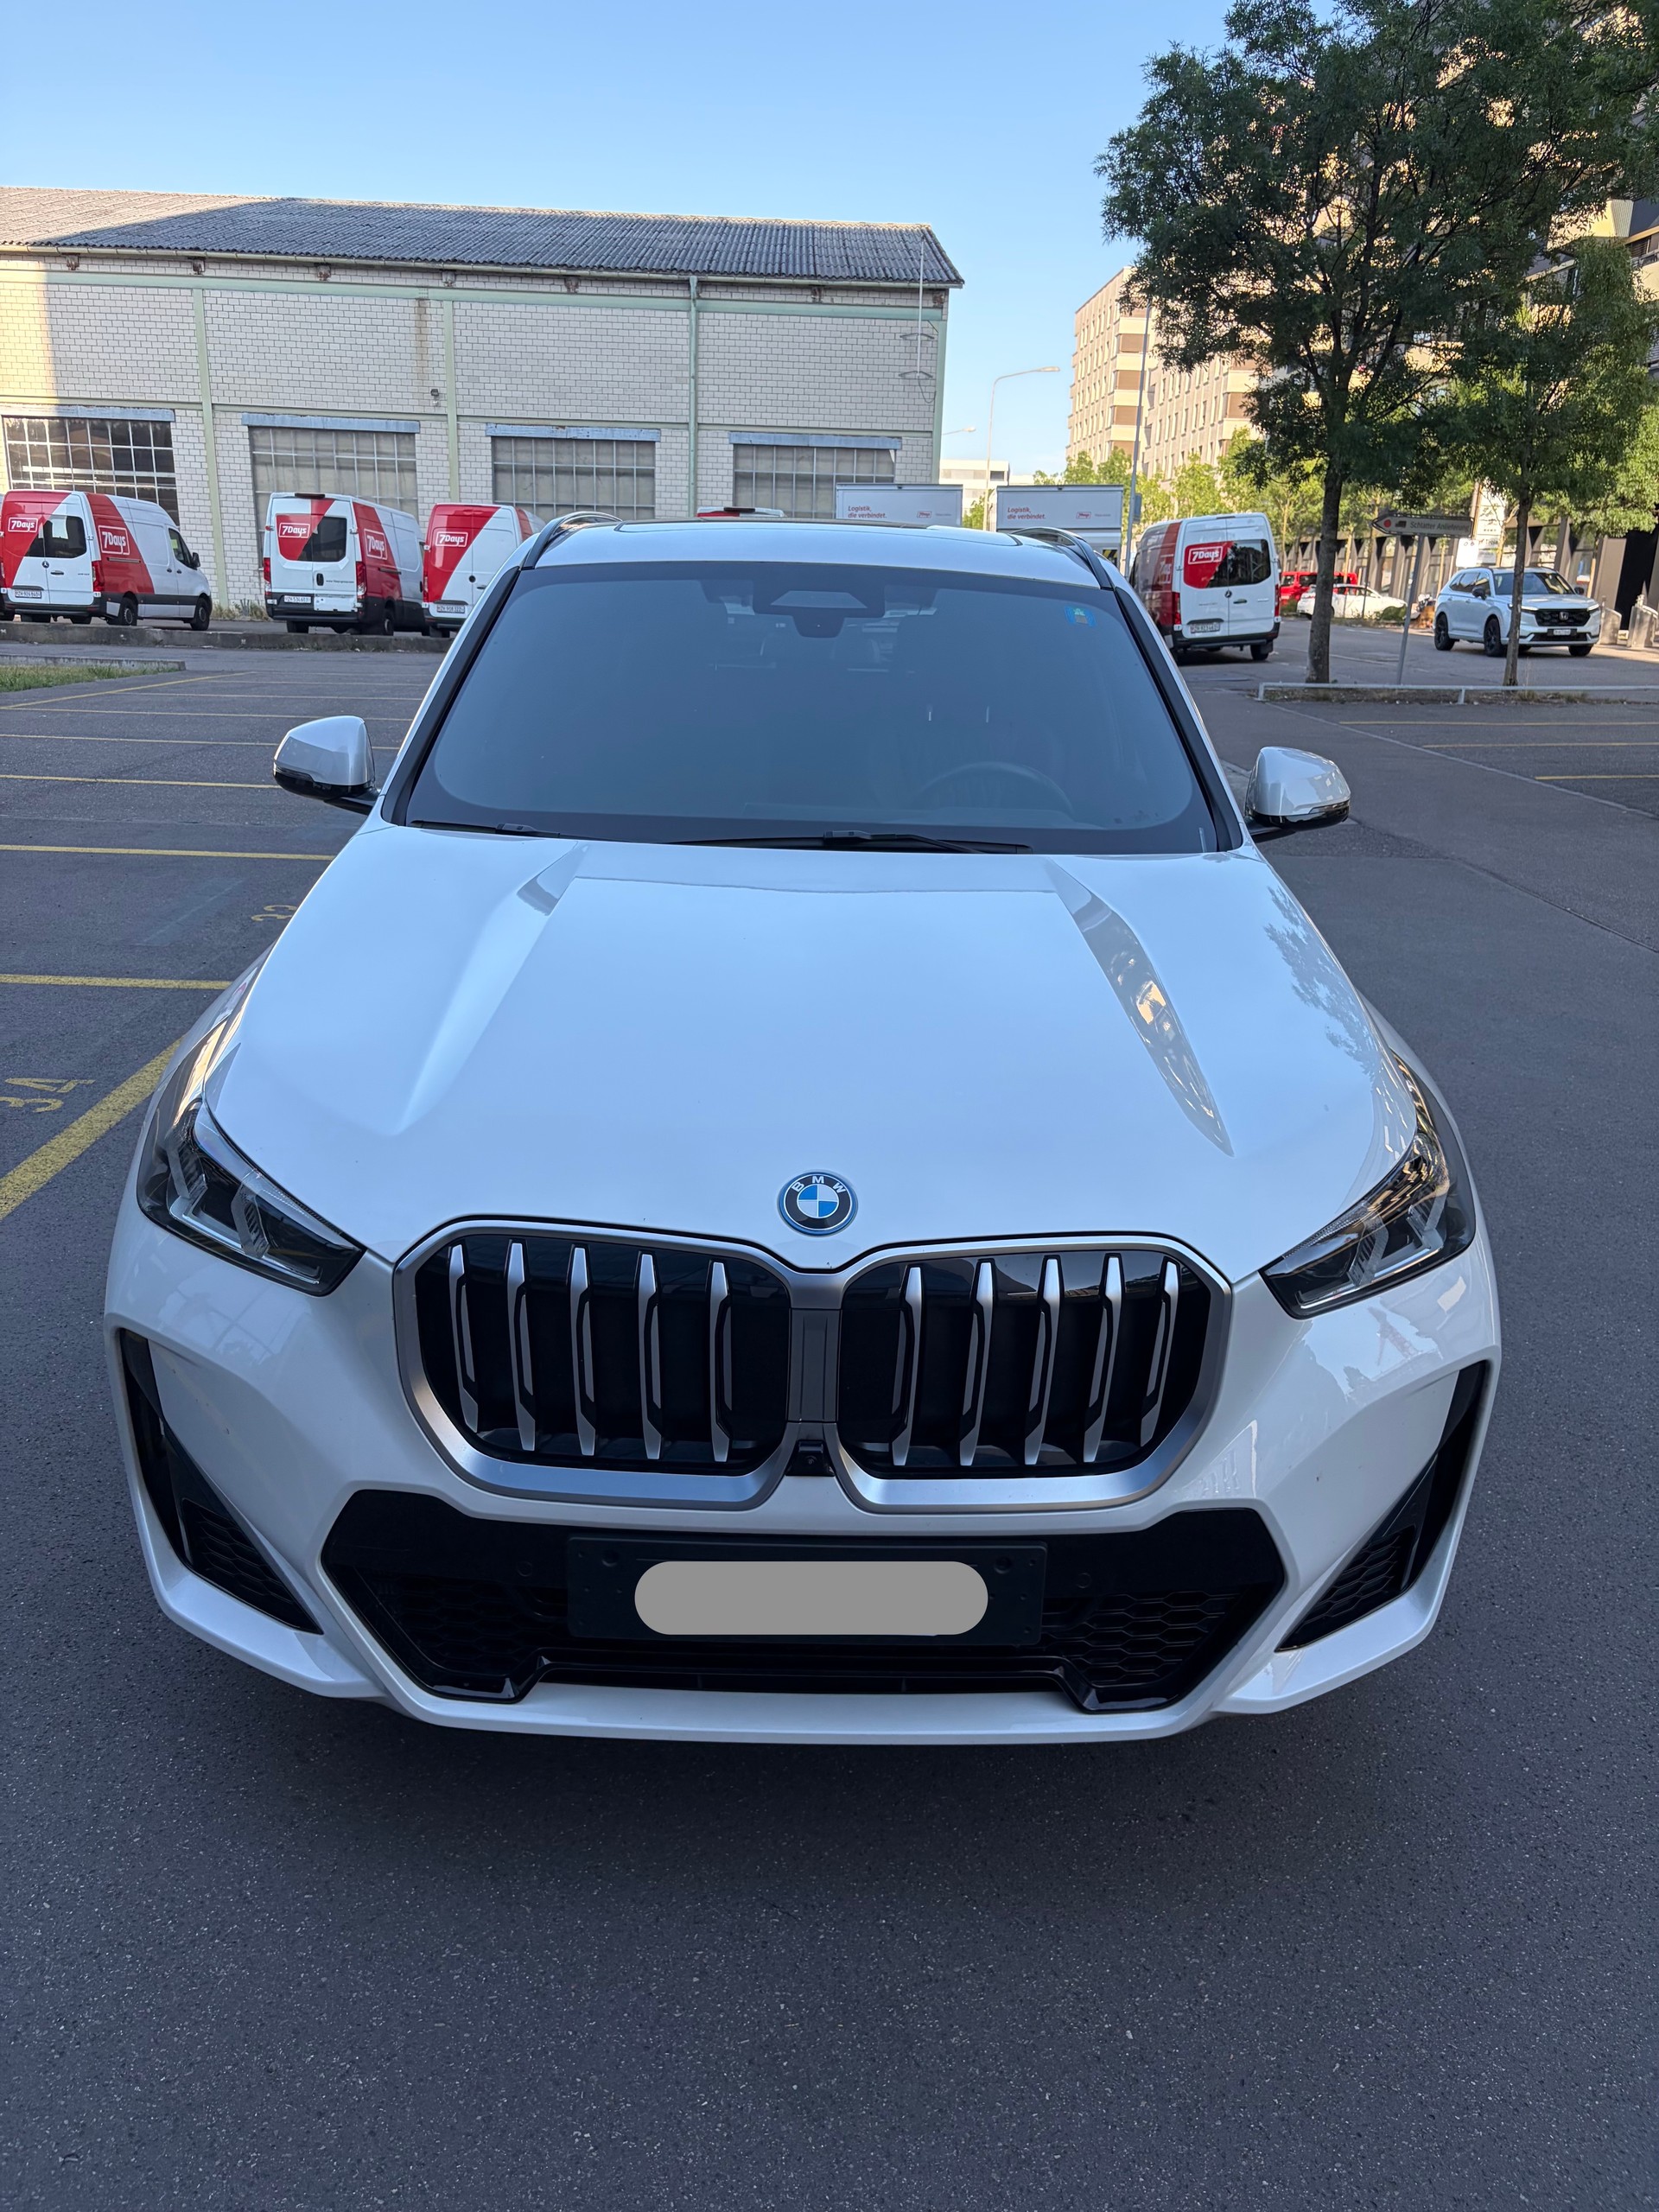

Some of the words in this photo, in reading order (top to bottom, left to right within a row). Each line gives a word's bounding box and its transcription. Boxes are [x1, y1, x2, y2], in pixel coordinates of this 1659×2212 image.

[11, 520, 35, 531] 7Days
[282, 525, 307, 537] 7Days
[102, 531, 126, 550] 7Days
[367, 535, 385, 555] 7Days
[439, 534, 465, 546] 7Days
[1192, 550, 1219, 562] 7Days
[791, 1176, 847, 1193] BMW
